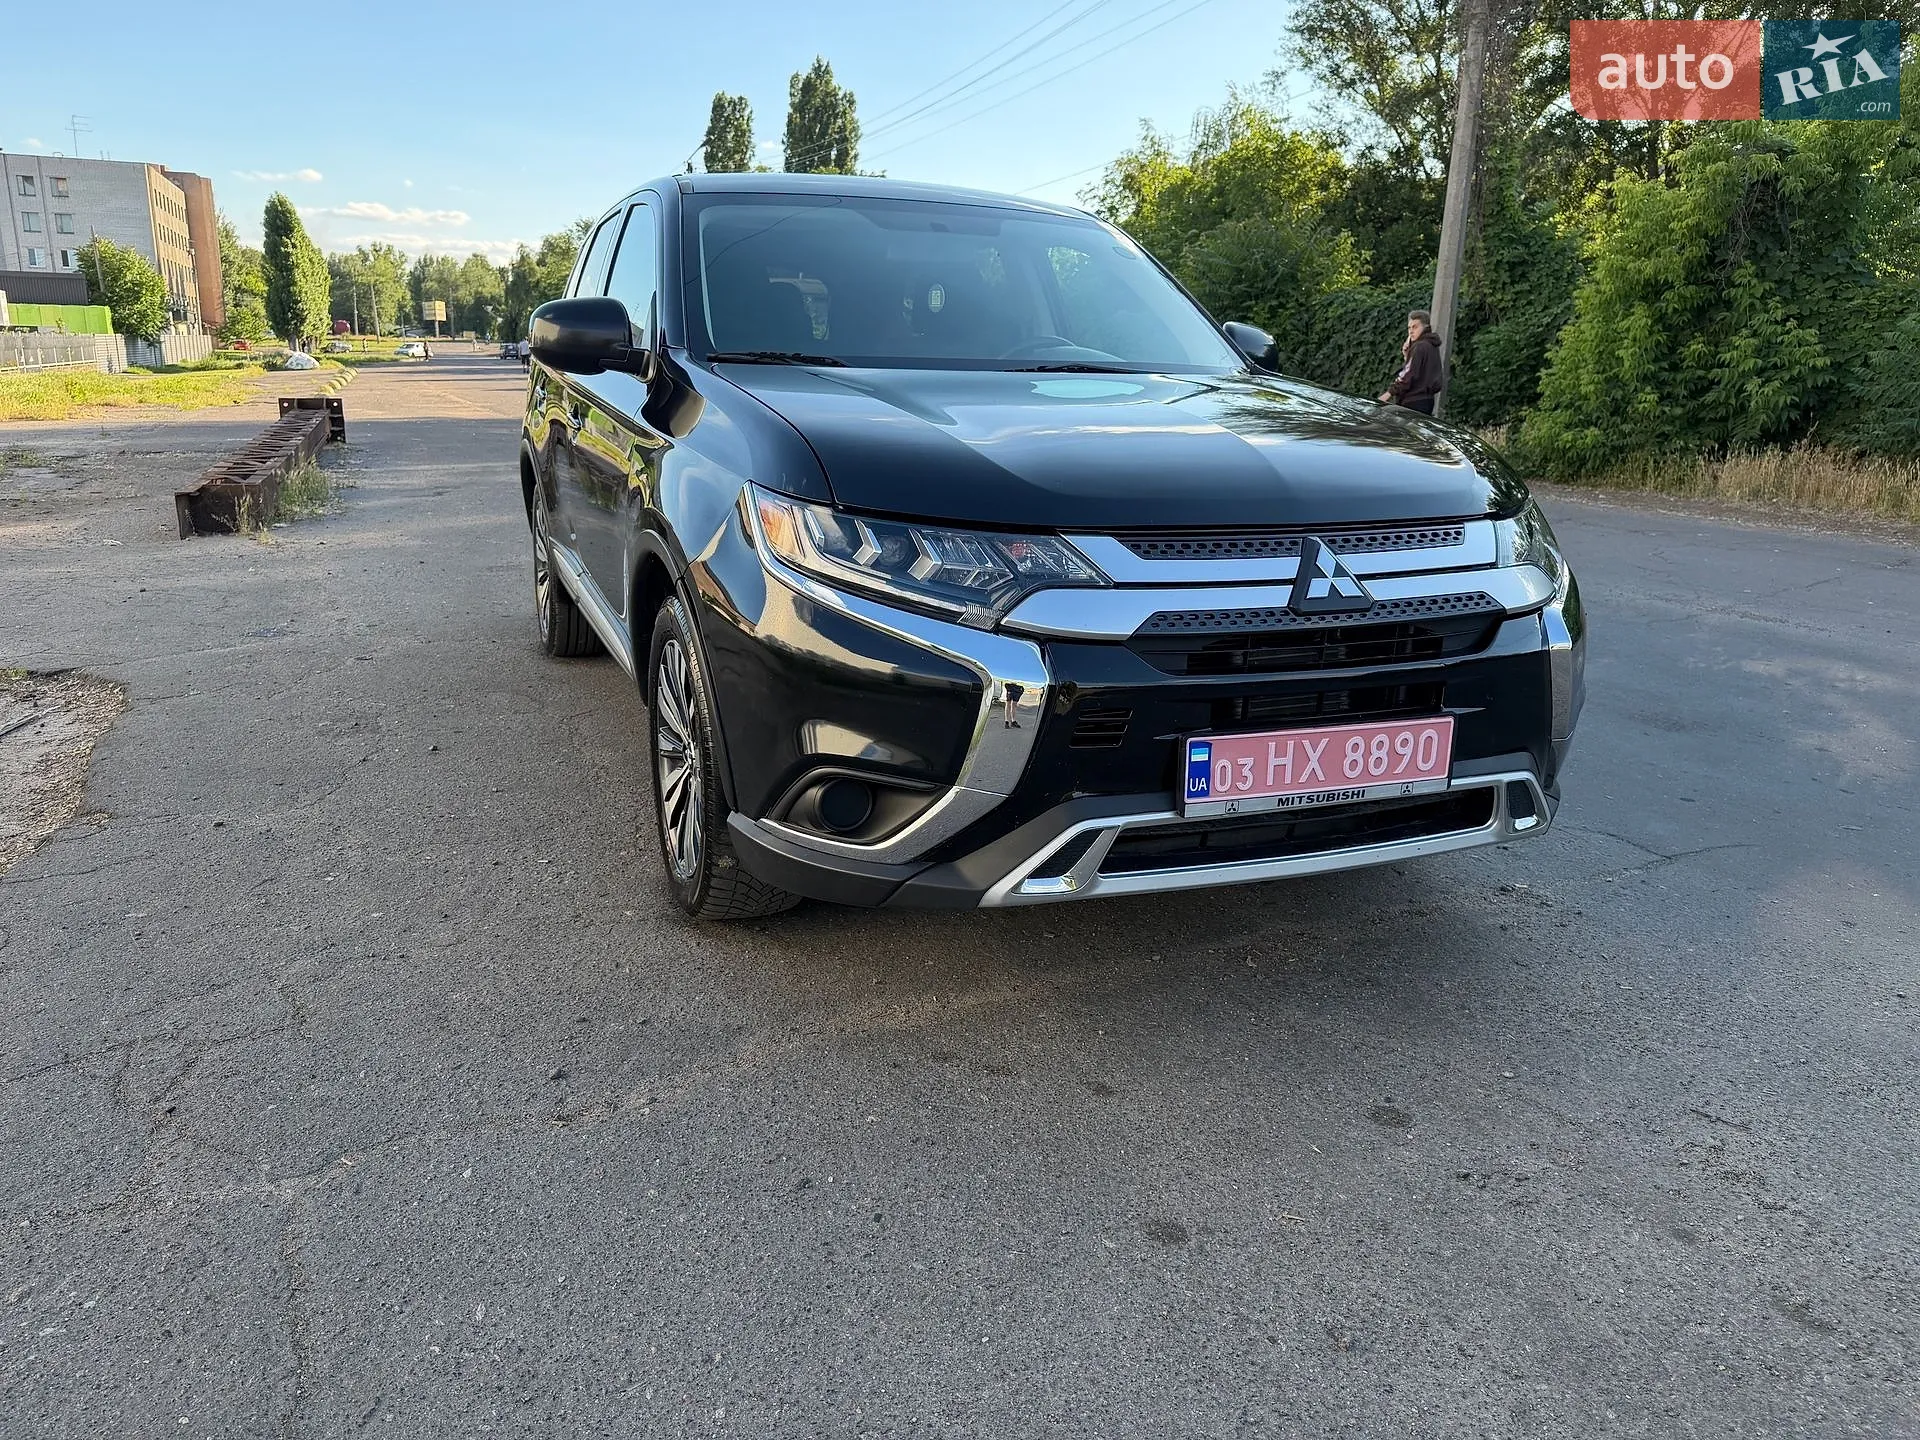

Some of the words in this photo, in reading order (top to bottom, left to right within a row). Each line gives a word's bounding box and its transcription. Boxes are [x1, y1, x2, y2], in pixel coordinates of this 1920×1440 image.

[1214, 758, 1254, 792] 03
[1267, 738, 1329, 786] HX
[1343, 729, 1439, 779] 8890
[1190, 778, 1207, 792] UA
[1277, 790, 1366, 807] MITSUBISHI
